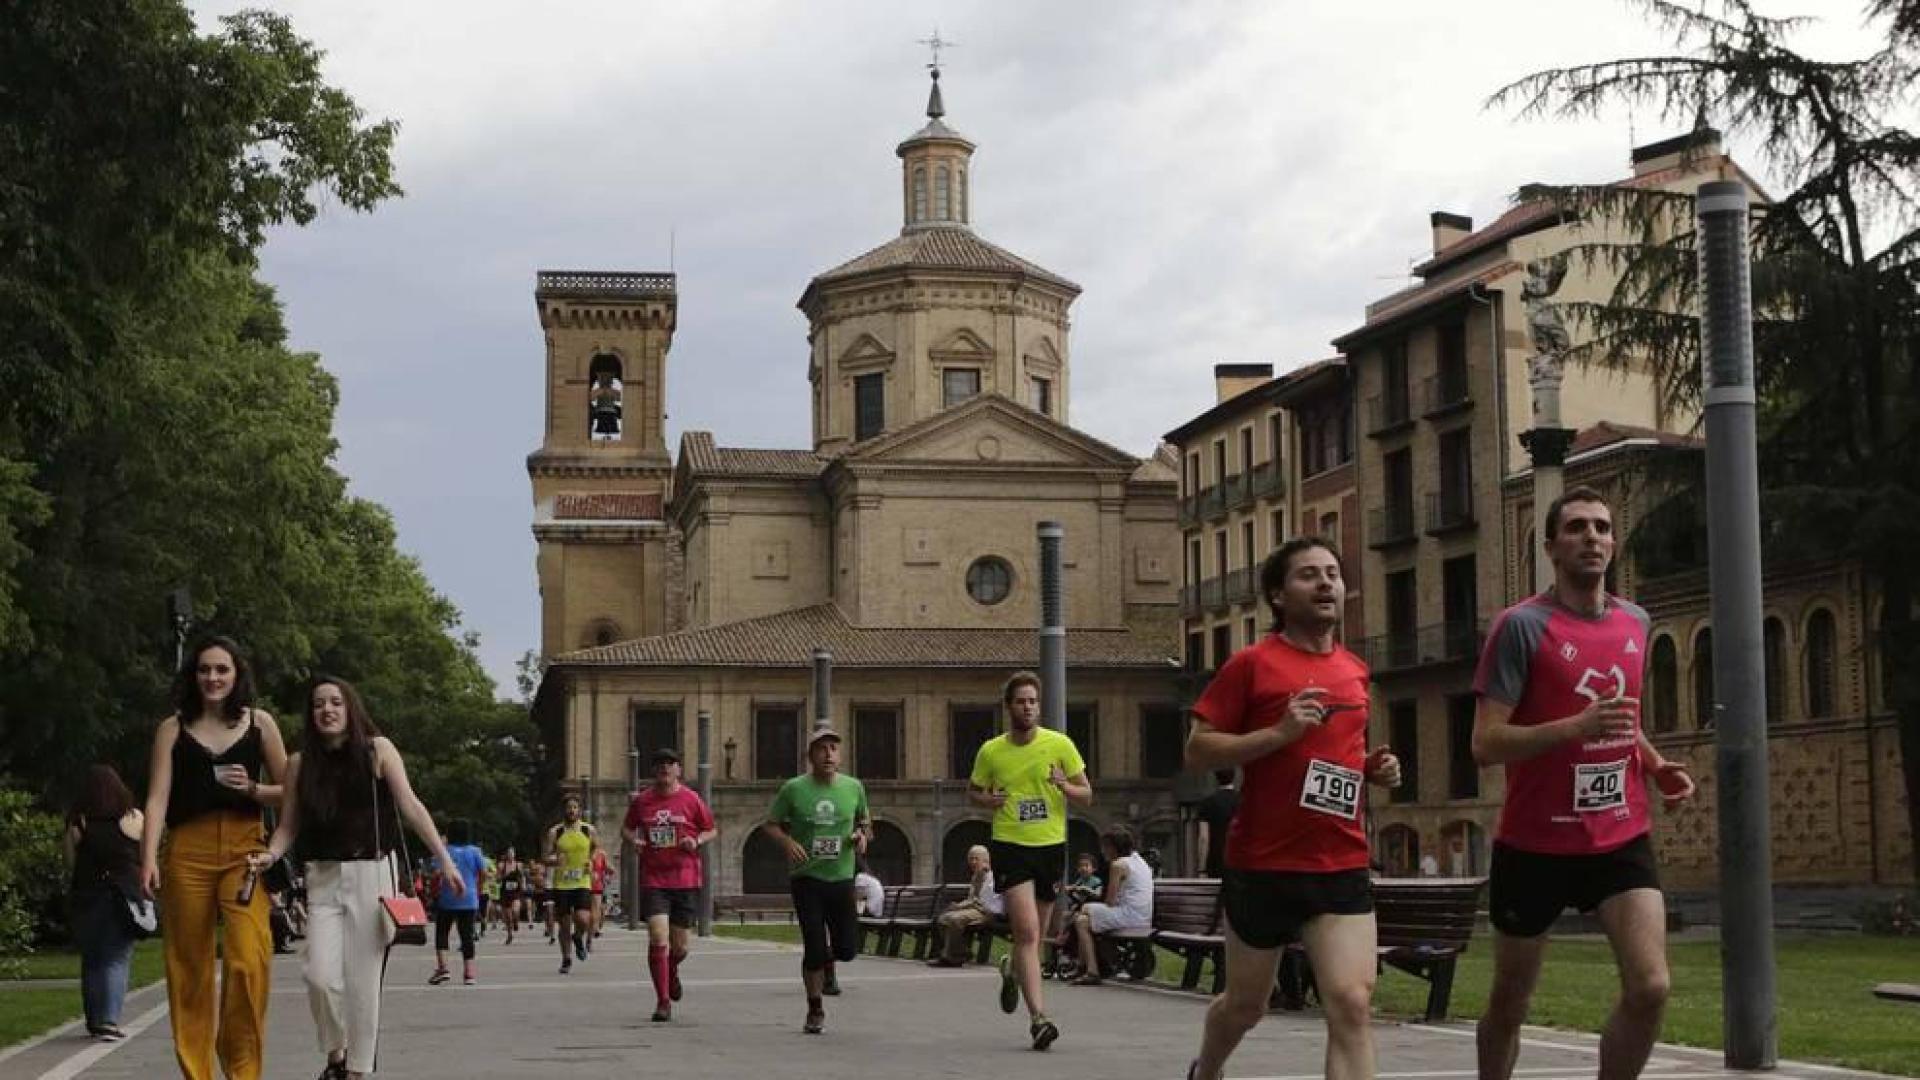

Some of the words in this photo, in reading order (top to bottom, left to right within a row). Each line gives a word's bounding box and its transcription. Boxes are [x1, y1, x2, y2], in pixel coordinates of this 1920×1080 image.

[1314, 774, 1356, 802] 190
[1589, 773, 1618, 795] 40
[1020, 803, 1046, 817] 204
